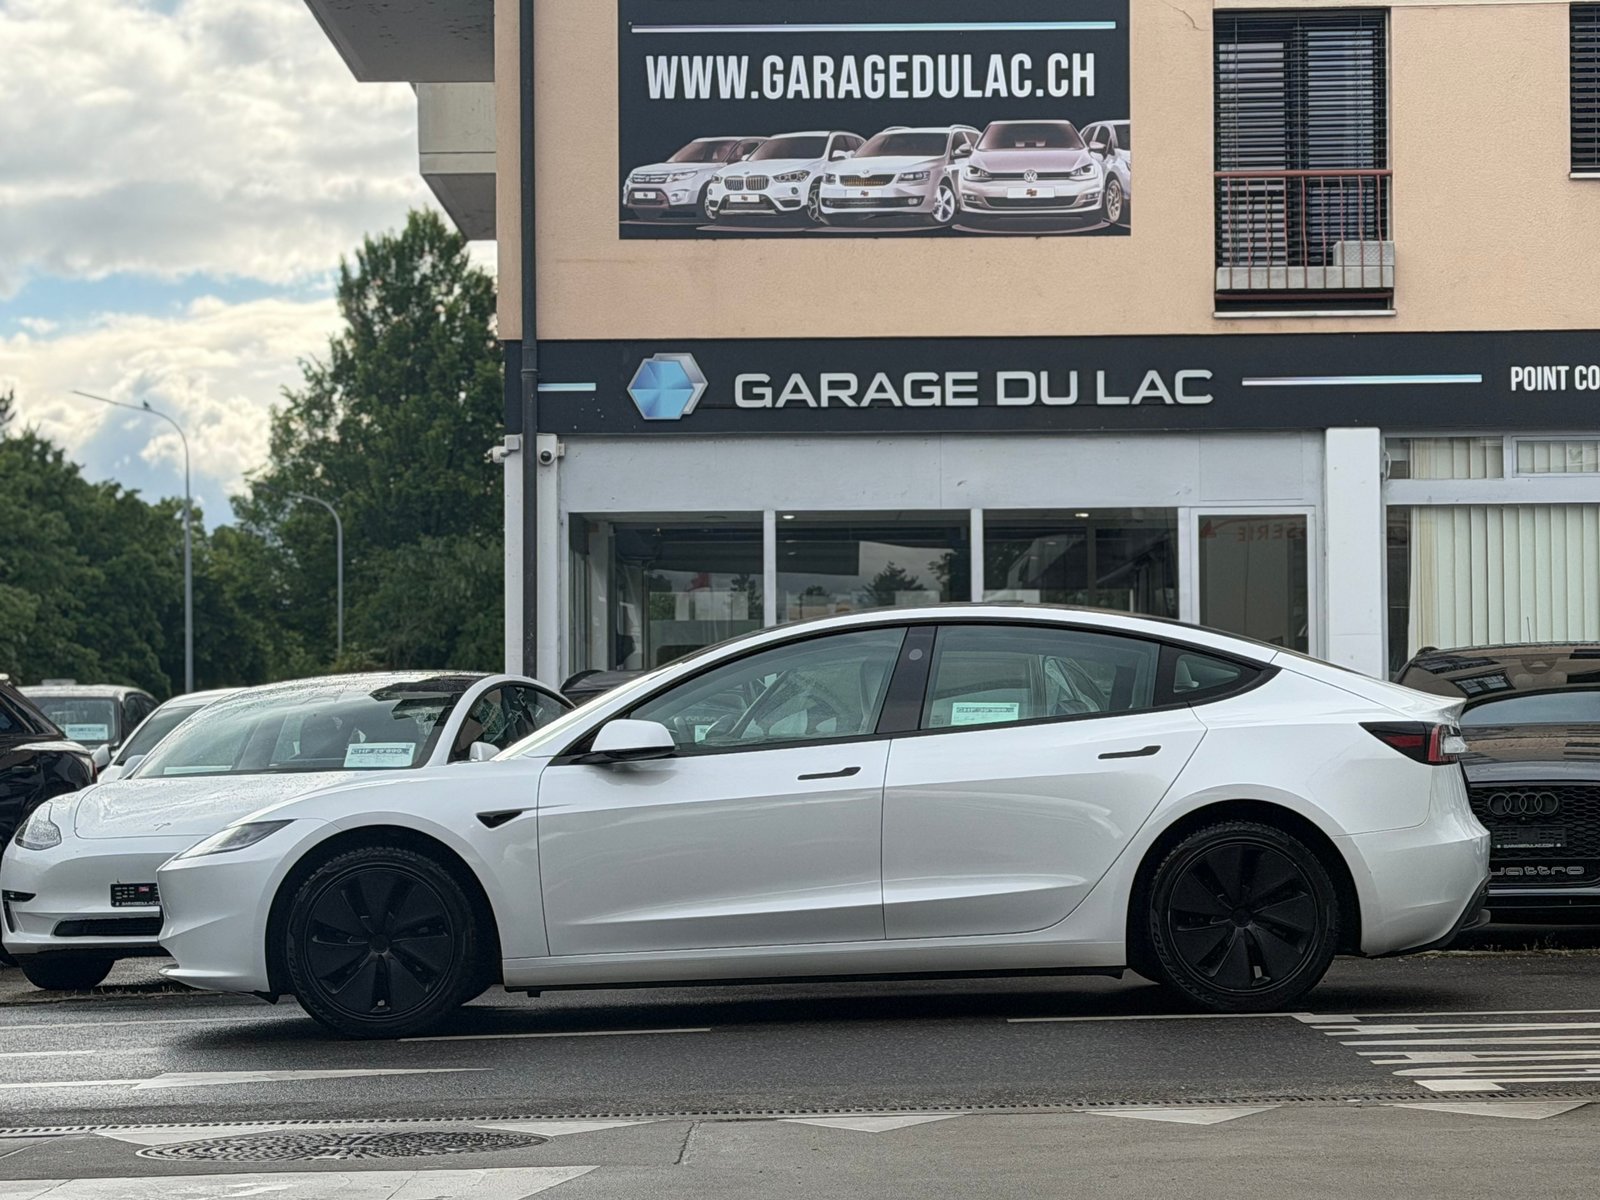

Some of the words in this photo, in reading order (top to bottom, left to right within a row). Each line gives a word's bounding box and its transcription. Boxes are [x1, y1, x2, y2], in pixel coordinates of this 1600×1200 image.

[645, 53, 1096, 99] WWW.GARAGEDULAC.CH
[734, 371, 979, 408] GARAGE
[996, 370, 1078, 406] DU
[1096, 369, 1214, 405] LAC
[1510, 365, 1570, 391] POINT
[1488, 866, 1585, 876] uattro
